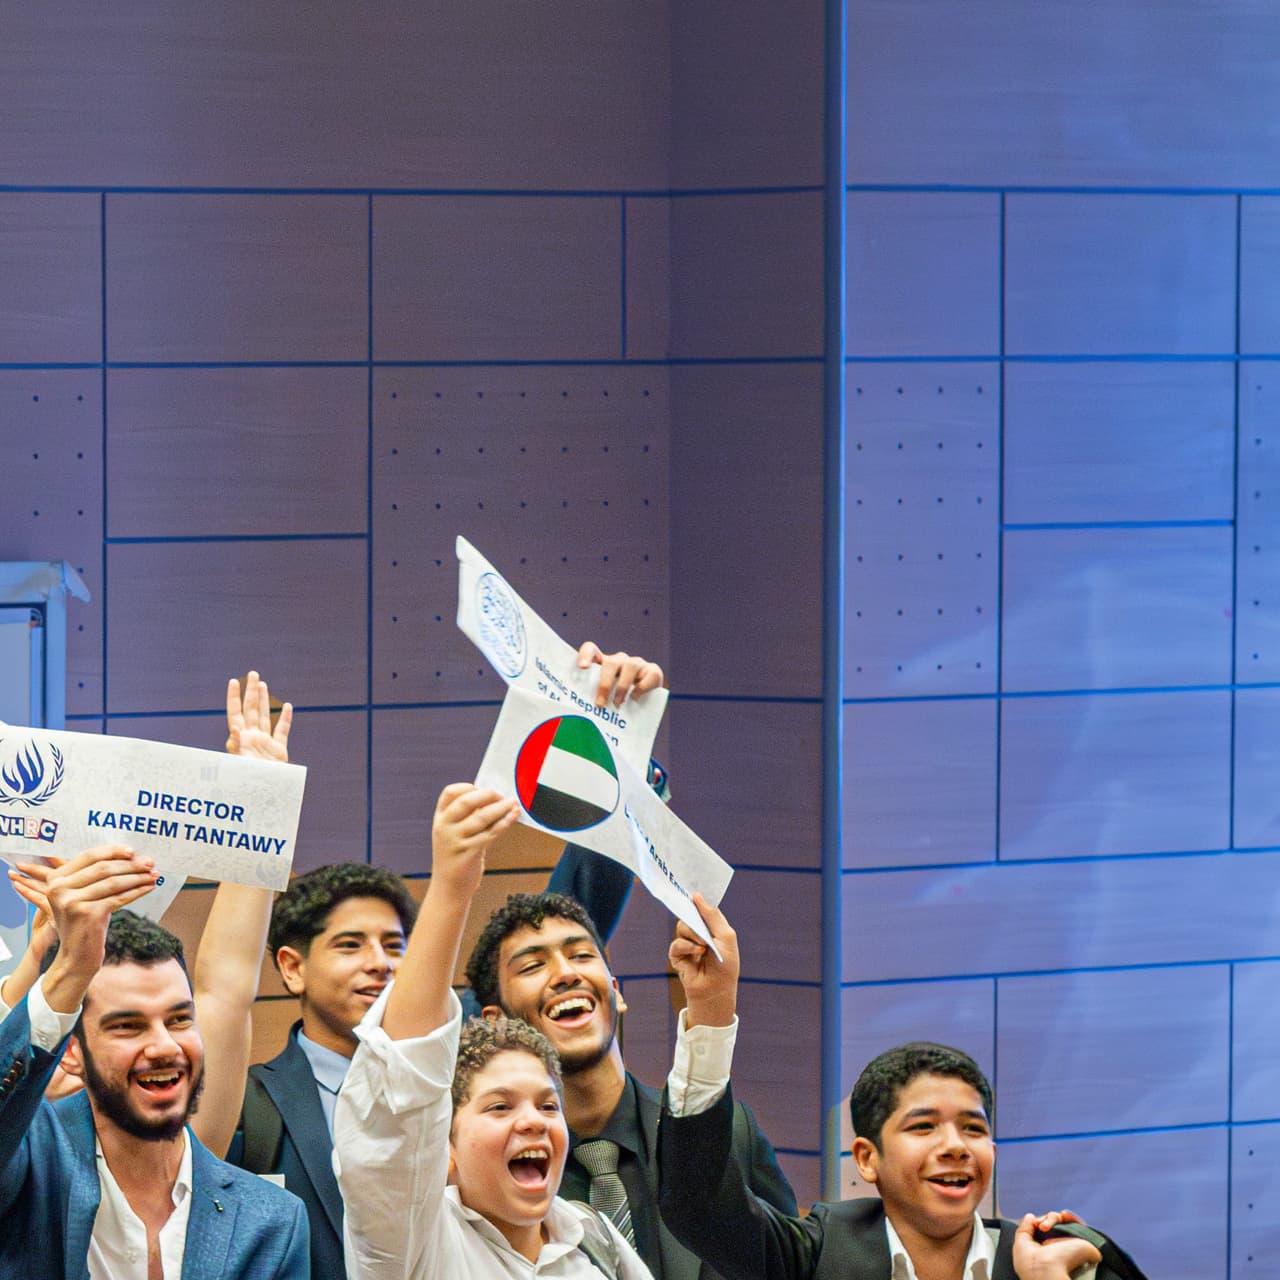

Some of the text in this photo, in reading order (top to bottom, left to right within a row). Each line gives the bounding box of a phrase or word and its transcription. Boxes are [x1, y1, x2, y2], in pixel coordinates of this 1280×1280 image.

[536, 657, 627, 729] Islamic Republic
[137, 790, 245, 823] DIRECTOR
[88, 810, 286, 855] KAREEM TANTAWY
